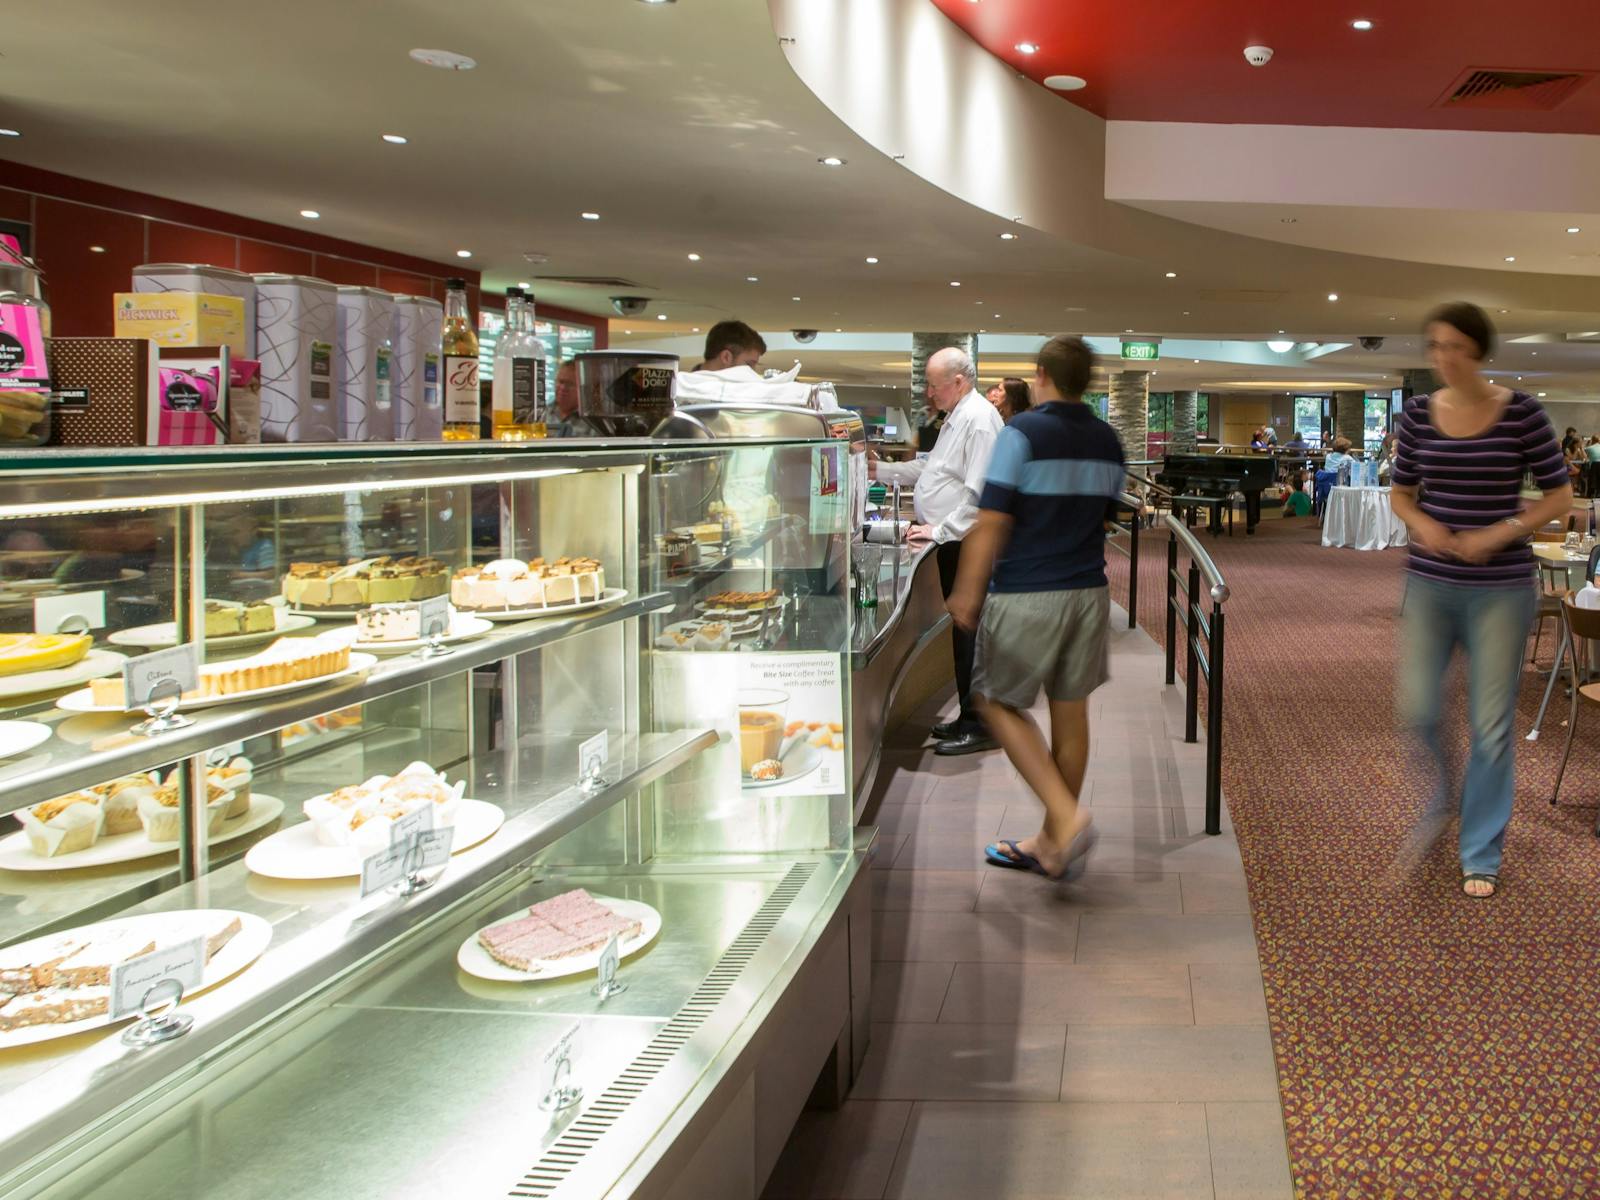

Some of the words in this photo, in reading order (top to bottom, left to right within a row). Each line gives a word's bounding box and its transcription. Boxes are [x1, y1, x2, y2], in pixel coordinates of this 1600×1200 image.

[1130, 345, 1151, 358] EXIT
[642, 368, 672, 378] PIAZZA
[813, 678, 835, 687] coffee
